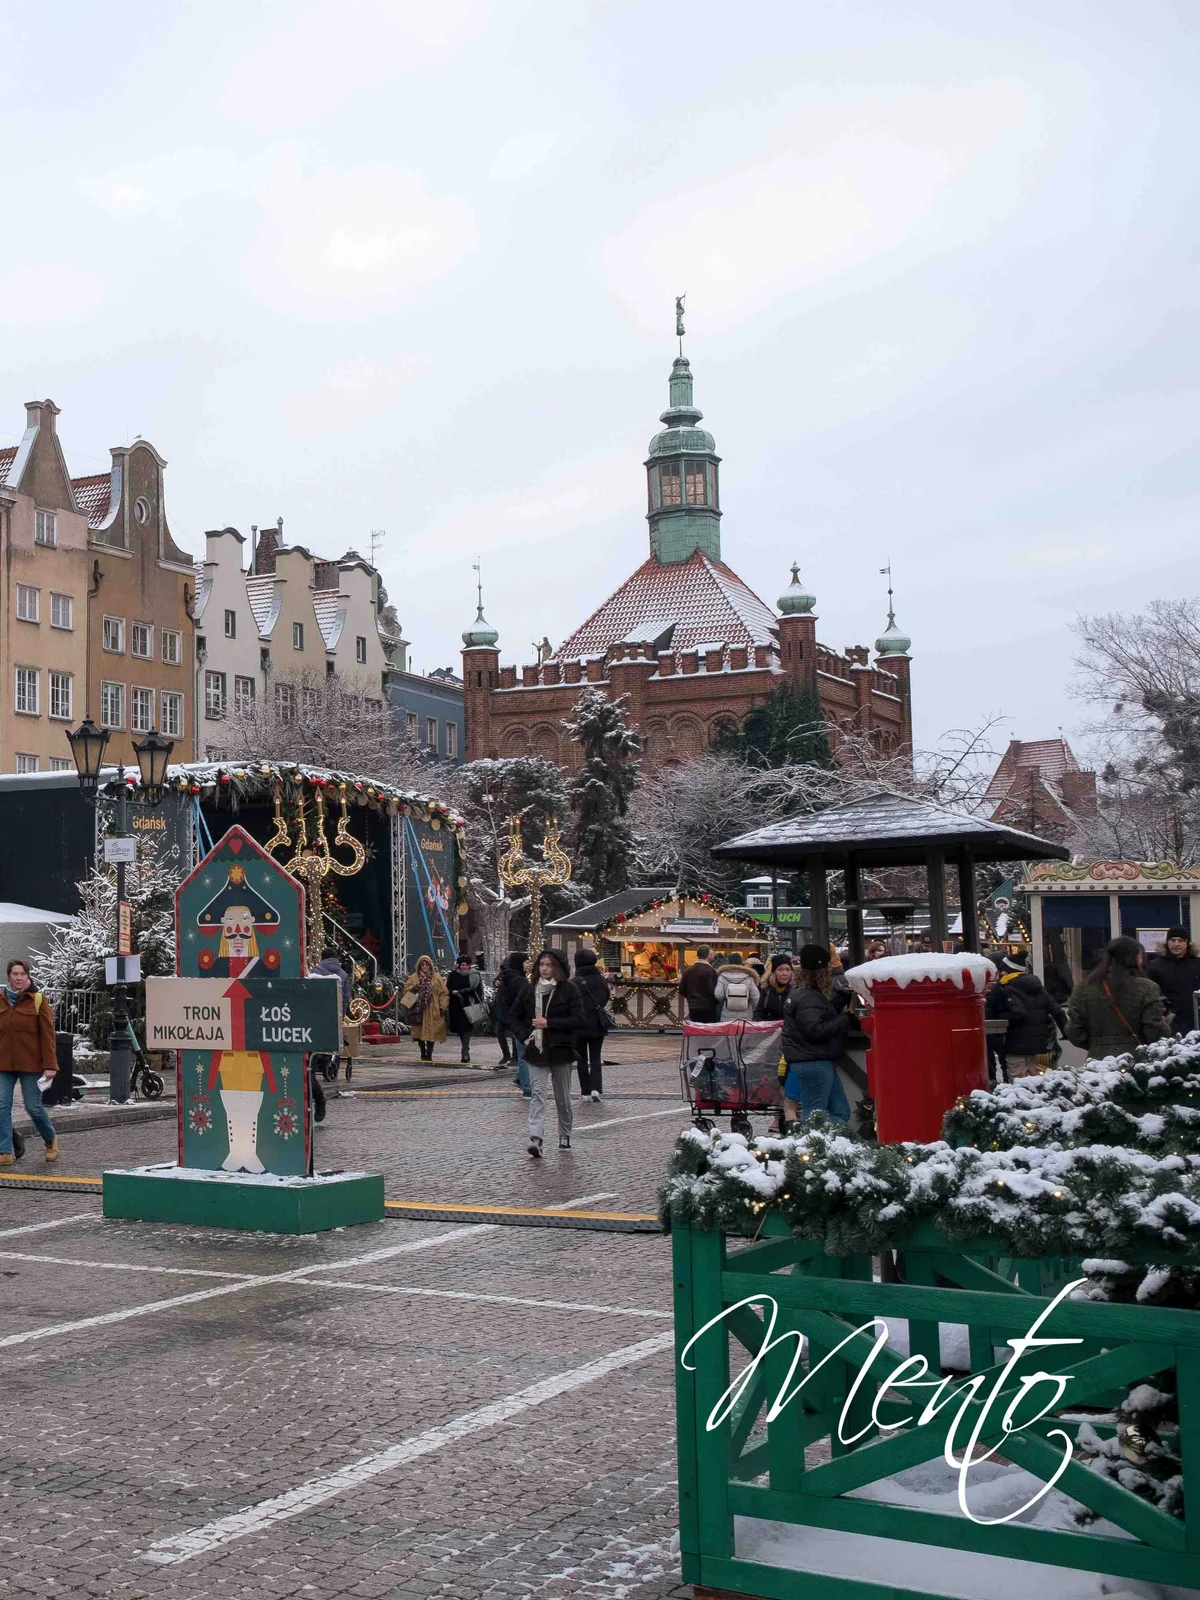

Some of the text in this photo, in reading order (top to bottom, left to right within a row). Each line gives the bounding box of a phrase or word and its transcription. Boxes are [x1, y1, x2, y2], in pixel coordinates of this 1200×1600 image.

[133, 816, 167, 830] Gdańsk
[772, 913, 801, 922] UCH
[183, 1006, 221, 1020] TRON
[260, 1003, 291, 1021] ŁOŚ
[153, 1026, 225, 1041] MIKOŁAJA
[262, 1027, 313, 1042] LUCEK
